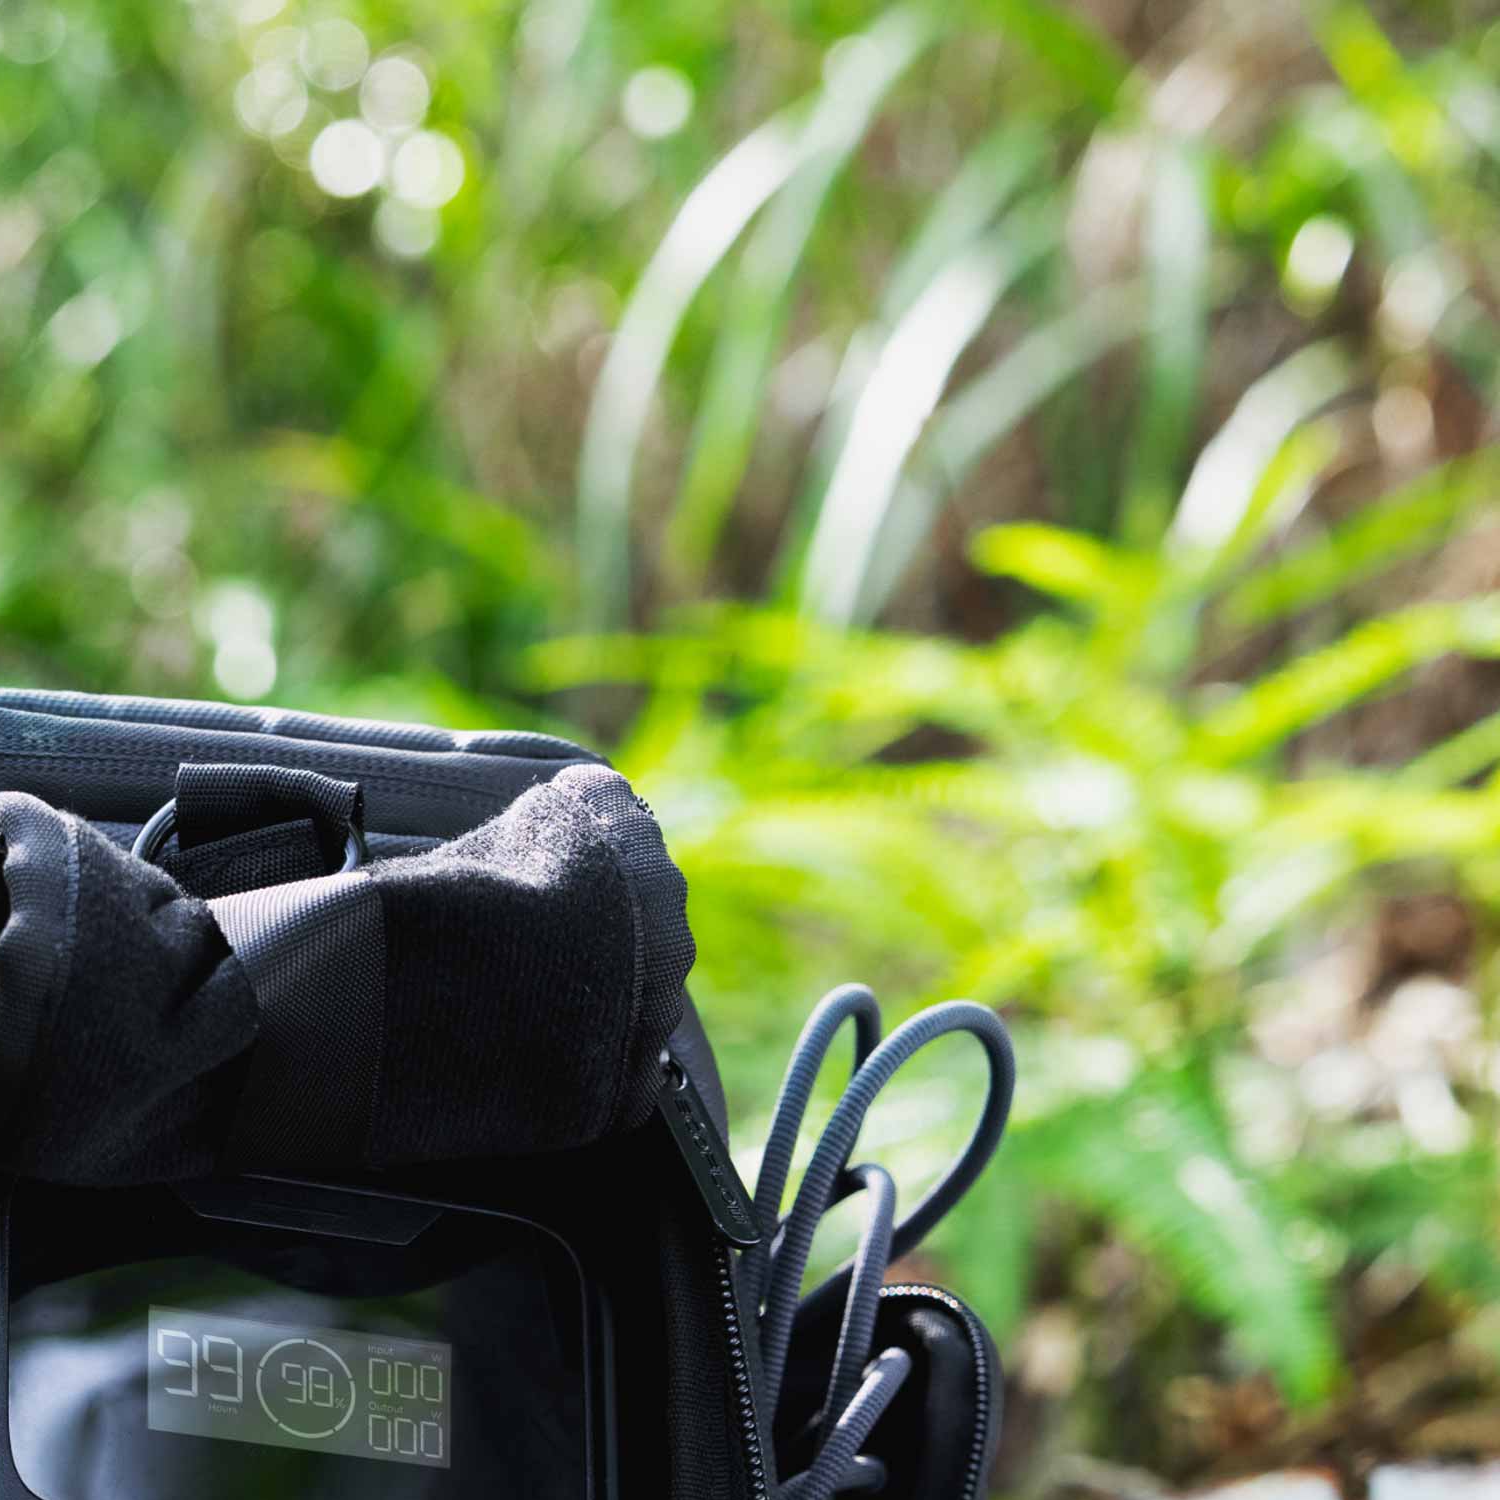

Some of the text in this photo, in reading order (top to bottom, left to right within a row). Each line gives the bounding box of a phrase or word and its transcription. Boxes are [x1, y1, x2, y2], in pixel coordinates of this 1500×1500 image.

[368, 1344, 395, 1356] Input
[156, 1328, 244, 1403] 99
[368, 1358, 443, 1402] 000
[208, 1403, 239, 1416] Hours
[368, 1402, 405, 1415] Output
[368, 1414, 443, 1459] 000
